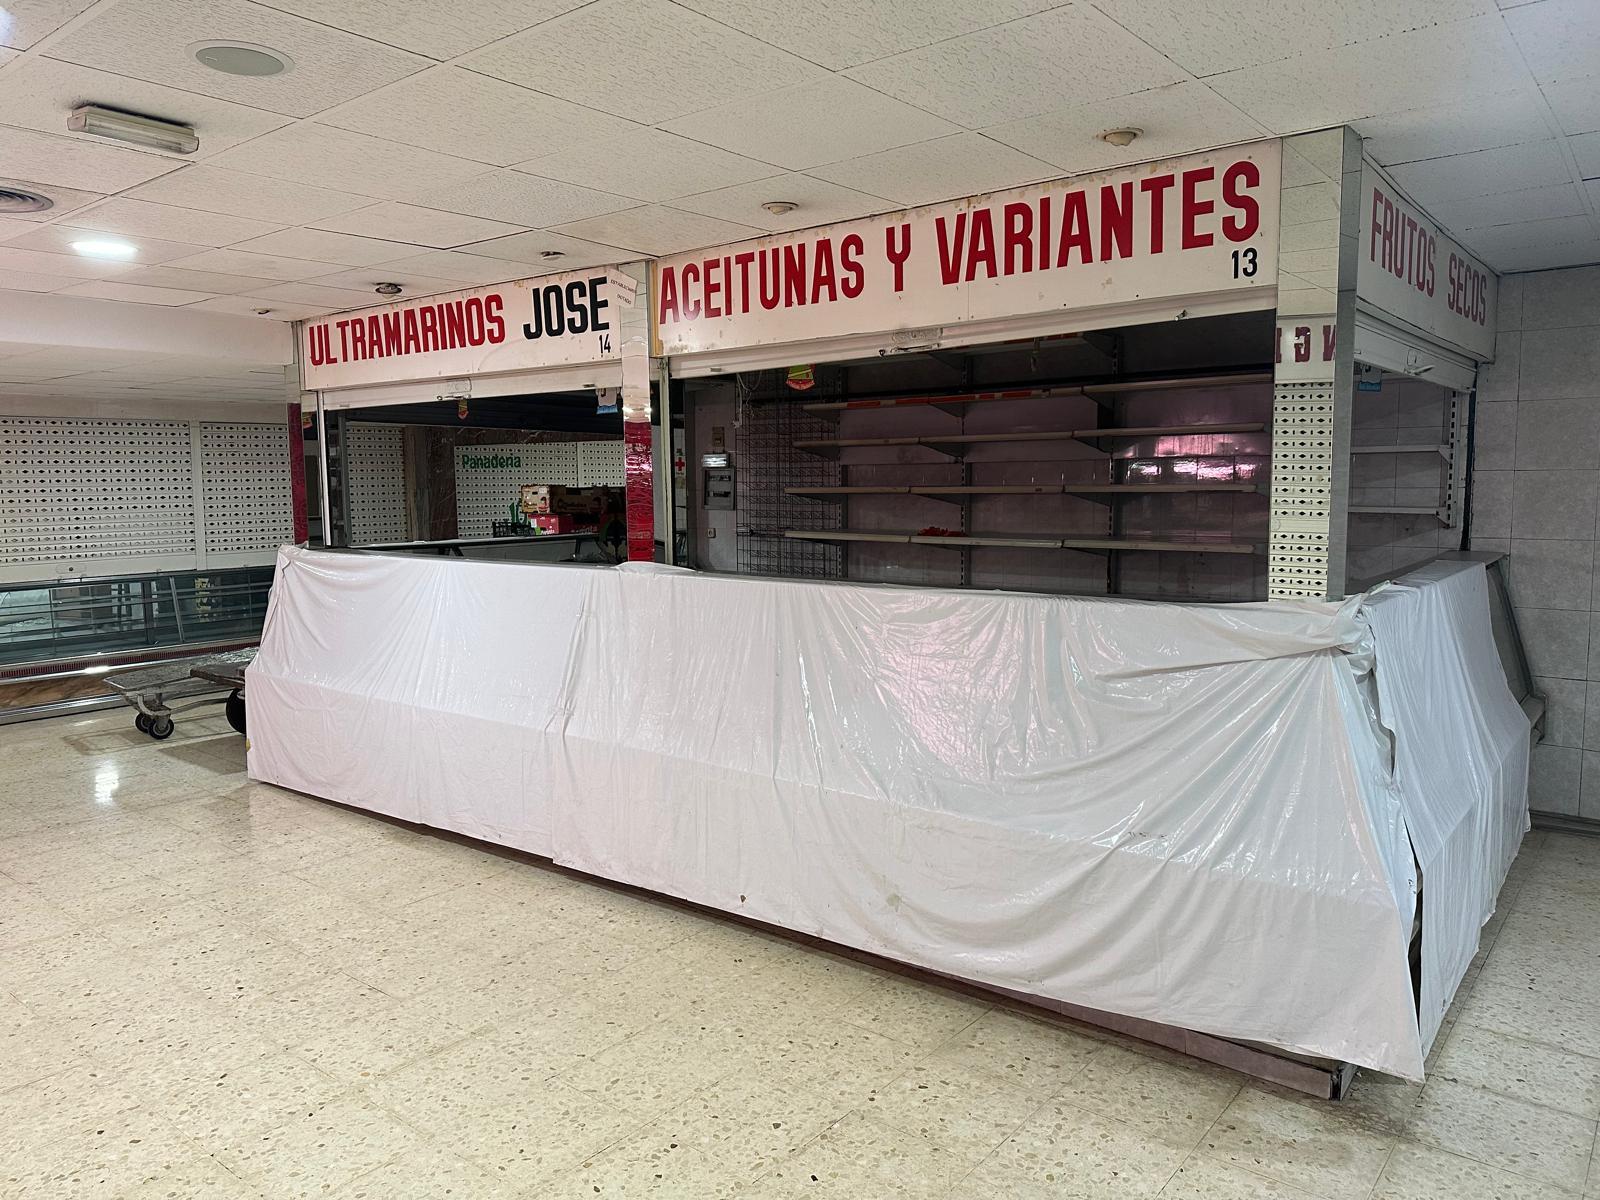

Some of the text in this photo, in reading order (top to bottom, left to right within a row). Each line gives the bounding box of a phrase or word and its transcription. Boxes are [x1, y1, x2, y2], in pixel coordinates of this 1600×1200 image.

[659, 160, 1260, 326] ACEITUNAS Y VARIANTES
[1231, 247, 1258, 279] 13
[1370, 187, 1488, 326] FRUTOS SECOS
[308, 276, 610, 367] ULTRAMARINOS JOSE
[598, 334, 611, 354] 14
